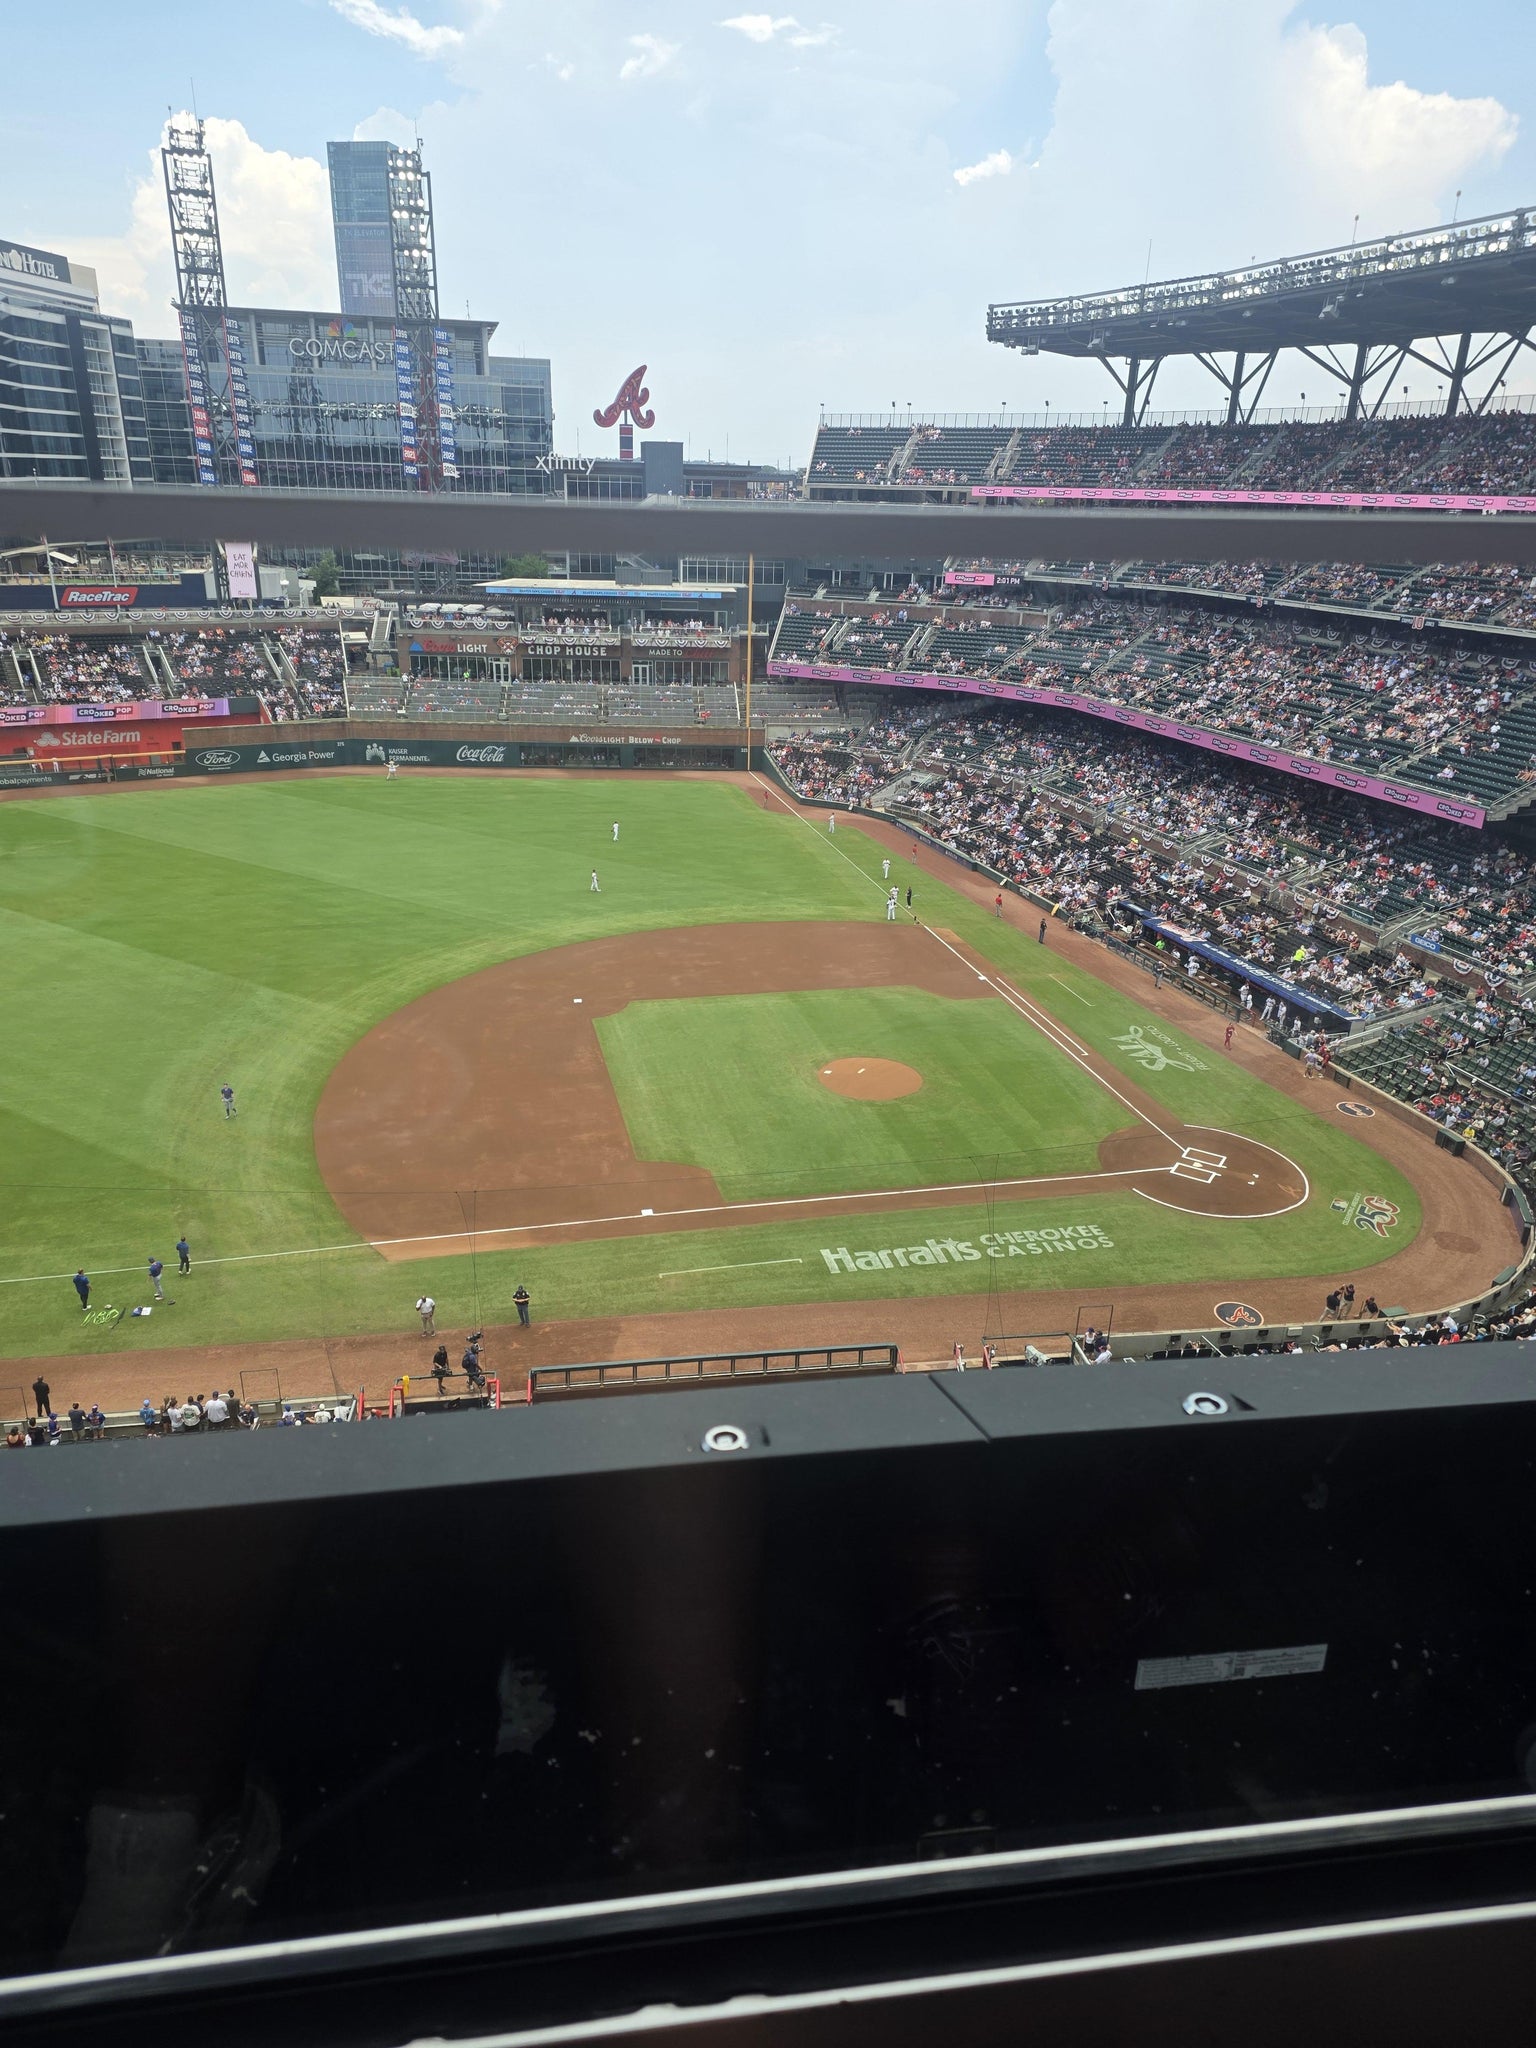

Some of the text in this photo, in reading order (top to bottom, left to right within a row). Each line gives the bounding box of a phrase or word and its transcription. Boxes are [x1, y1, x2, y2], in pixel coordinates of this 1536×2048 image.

[345, 273, 393, 298] TKE
[289, 338, 395, 361] COMCAST
[535, 451, 596, 475] xfinity
[233, 553, 246, 561] EAT
[233, 561, 248, 569] MOR
[230, 570, 253, 578] CHIKIN
[1010, 577, 1020, 585] PM
[67, 591, 130, 602] RaceTrac
[457, 643, 488, 653] LIGHT
[528, 645, 607, 656] CHOP HOUSE
[78, 709, 114, 717] CROOKED
[163, 705, 198, 713] CROOKED
[629, 736, 654, 744] BELOW
[661, 736, 682, 745] CHOP
[204, 752, 232, 764] Ford
[272, 750, 335, 763] Georgia Power
[456, 744, 507, 762] Coca-Cola
[147, 767, 174, 775] National
[1407, 794, 1419, 803] POP
[1438, 803, 1476, 819] CROOKED POP
[1414, 937, 1436, 950] GEICO
[979, 1224, 1105, 1246] CHEROKEE
[986, 1236, 1115, 1258] CASINOS
[820, 1237, 983, 1274] Harrah's
